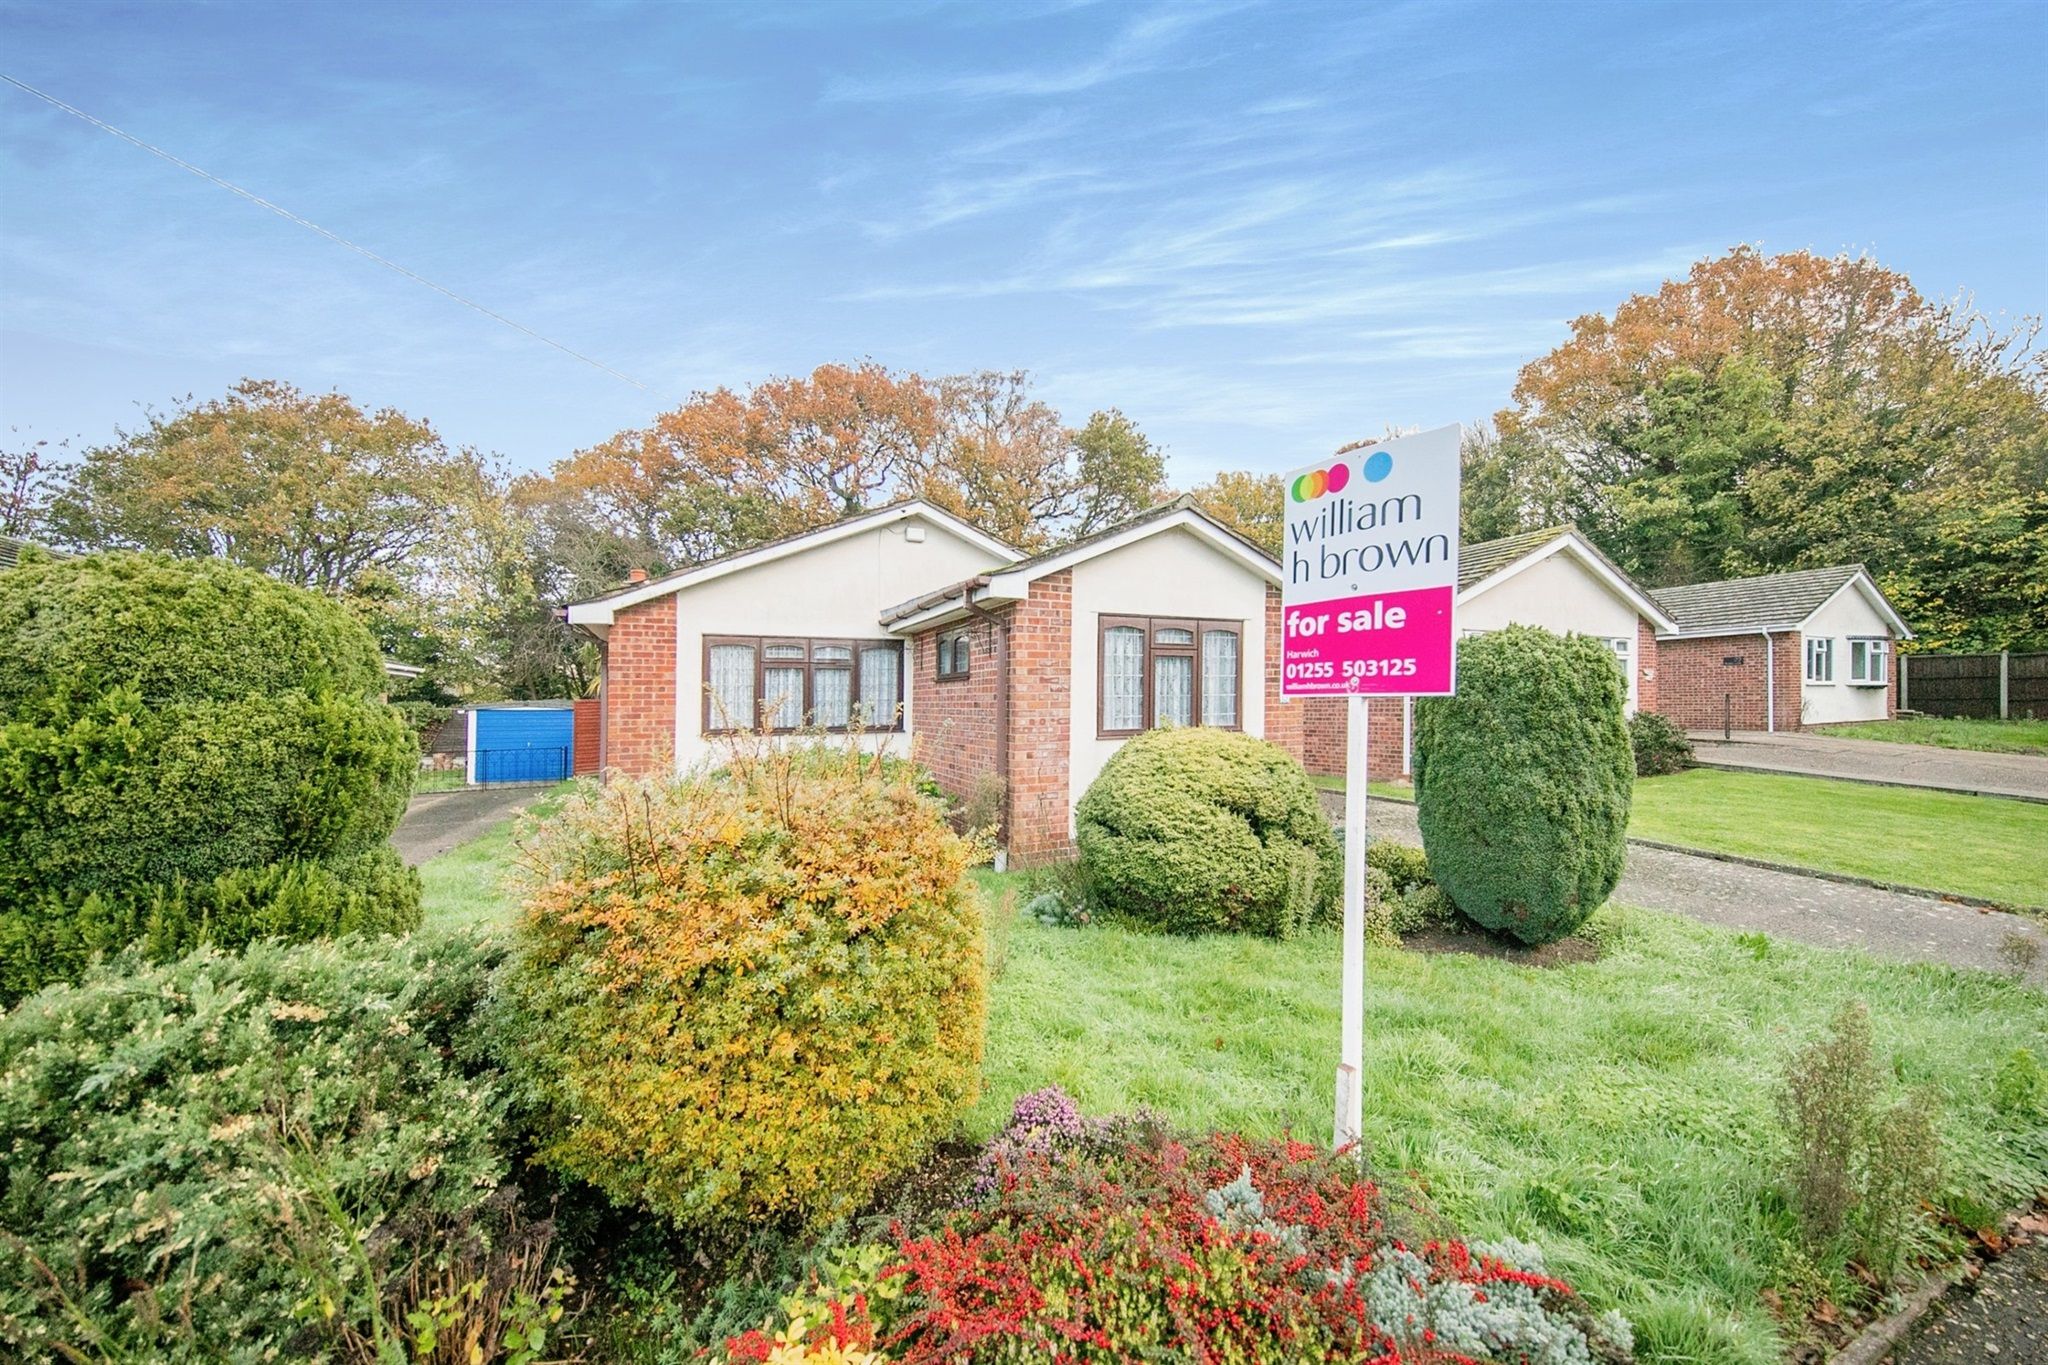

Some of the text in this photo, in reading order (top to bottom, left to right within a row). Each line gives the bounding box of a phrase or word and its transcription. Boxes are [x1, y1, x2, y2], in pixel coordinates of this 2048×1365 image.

[1291, 494, 1421, 544] william
[1293, 534, 1449, 584] h brown
[1287, 600, 1407, 638] for sale
[1286, 648, 1319, 659] Harwich
[1286, 658, 1417, 679] 01255 503125
